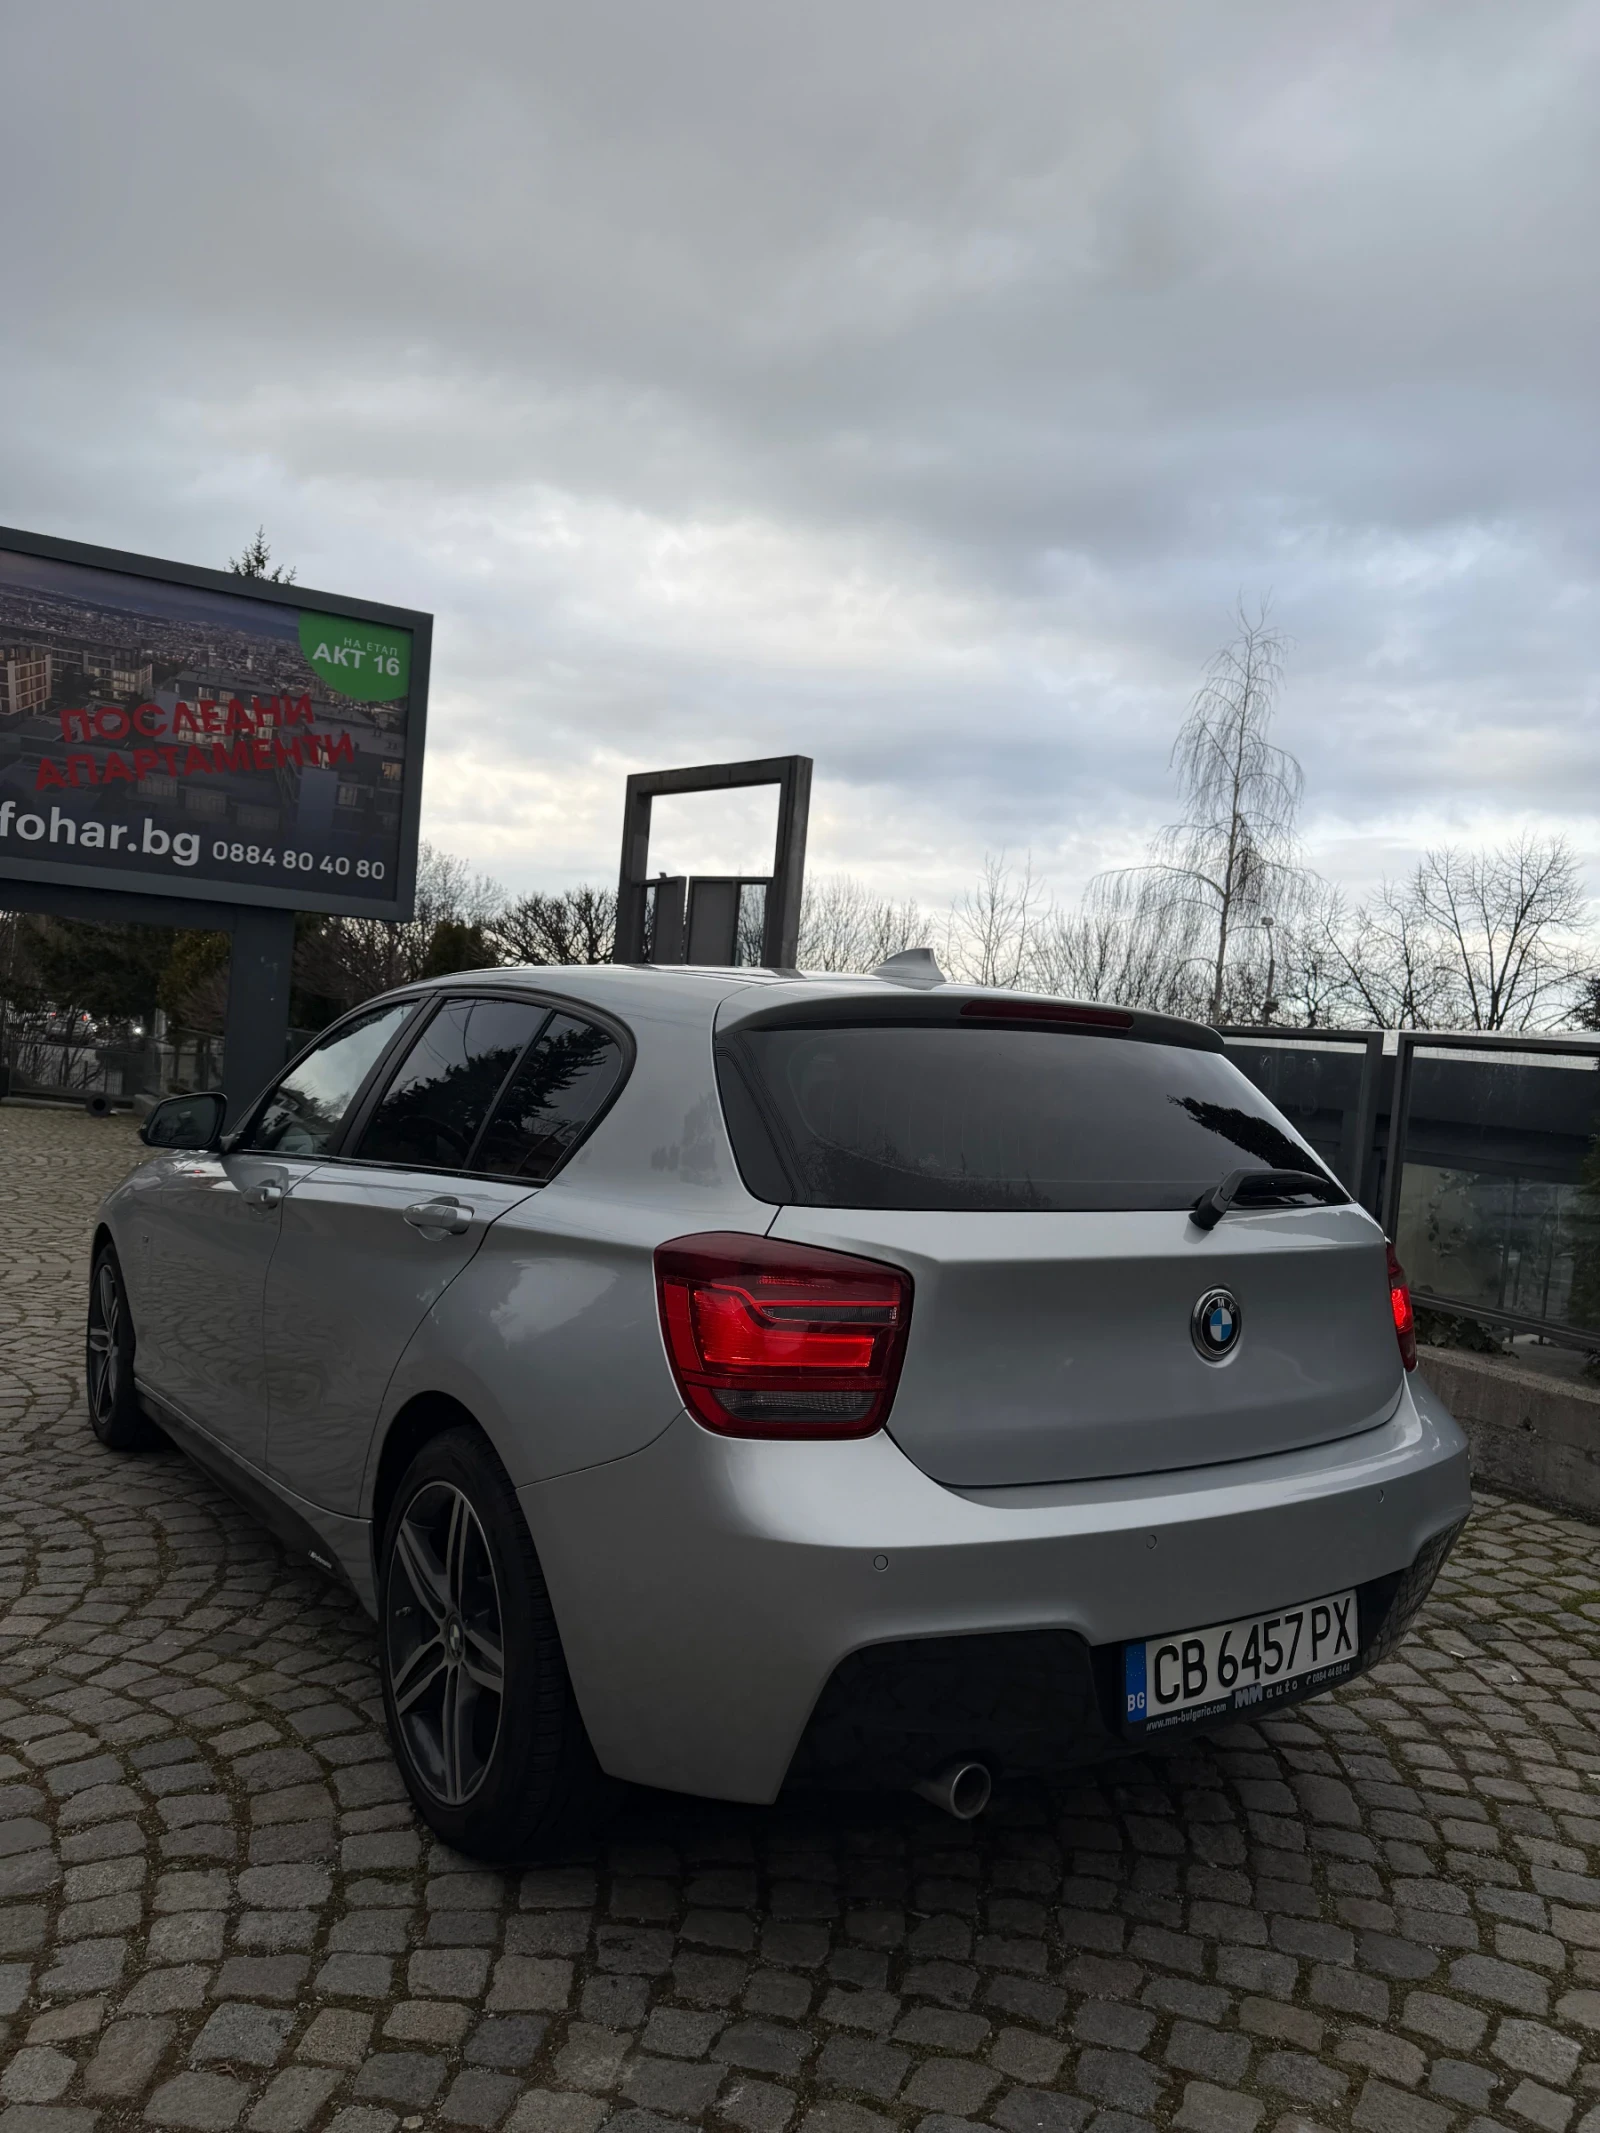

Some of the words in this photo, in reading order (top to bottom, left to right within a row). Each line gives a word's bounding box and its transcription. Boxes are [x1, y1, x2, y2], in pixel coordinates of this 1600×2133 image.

[312, 642, 366, 669] АКТ
[373, 655, 400, 676] 16
[343, 637, 361, 649] НА
[366, 641, 398, 657] ЕТАП
[59, 693, 315, 743] ПОСЛЕДНИ
[35, 732, 354, 791] АПАРТАМЕНТИ
[212, 840, 277, 867] 0884
[282, 851, 313, 871] 80
[319, 855, 350, 876] 40
[356, 860, 386, 880] 80
[1205, 1298, 1236, 1317] BMW
[1154, 1638, 1208, 1704] CB
[1217, 1611, 1303, 1688] 6457
[1311, 1597, 1352, 1662] PX
[1127, 1692, 1145, 1712] BG
[1234, 1686, 1263, 1709] MM
[1266, 1680, 1298, 1698] auto
[1146, 1702, 1227, 1732] www.mm-bulgaria.com
